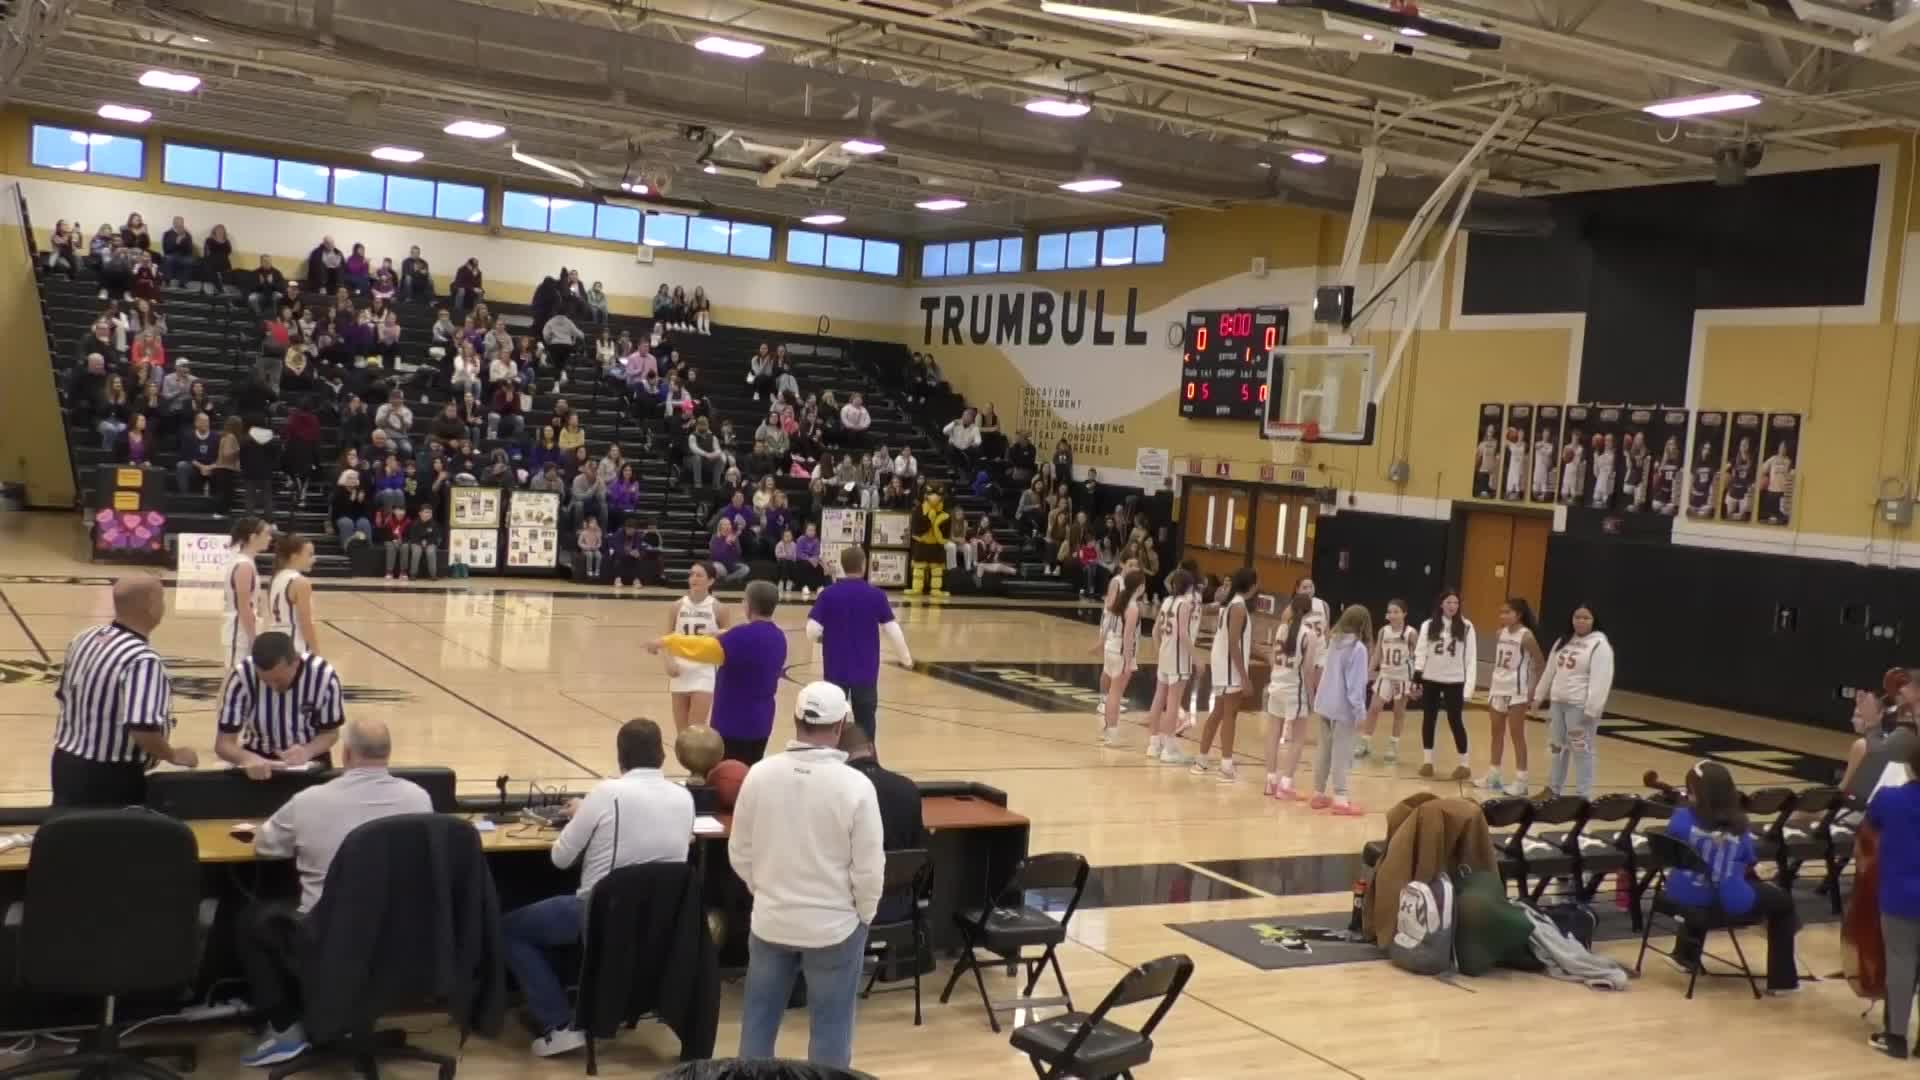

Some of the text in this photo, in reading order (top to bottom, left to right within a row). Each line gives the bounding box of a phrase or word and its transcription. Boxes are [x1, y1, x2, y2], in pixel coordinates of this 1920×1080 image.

[920, 287, 1148, 346] TRUMBULL
[1197, 327, 1207, 350] 0
[1264, 327, 1276, 351] 0
[1187, 383, 1195, 399] 0
[1201, 384, 1209, 400] 5
[1241, 384, 1249, 400] 5
[1385, 647, 1401, 667] 10
[1434, 637, 1457, 657] 24
[1497, 649, 1512, 671] 12
